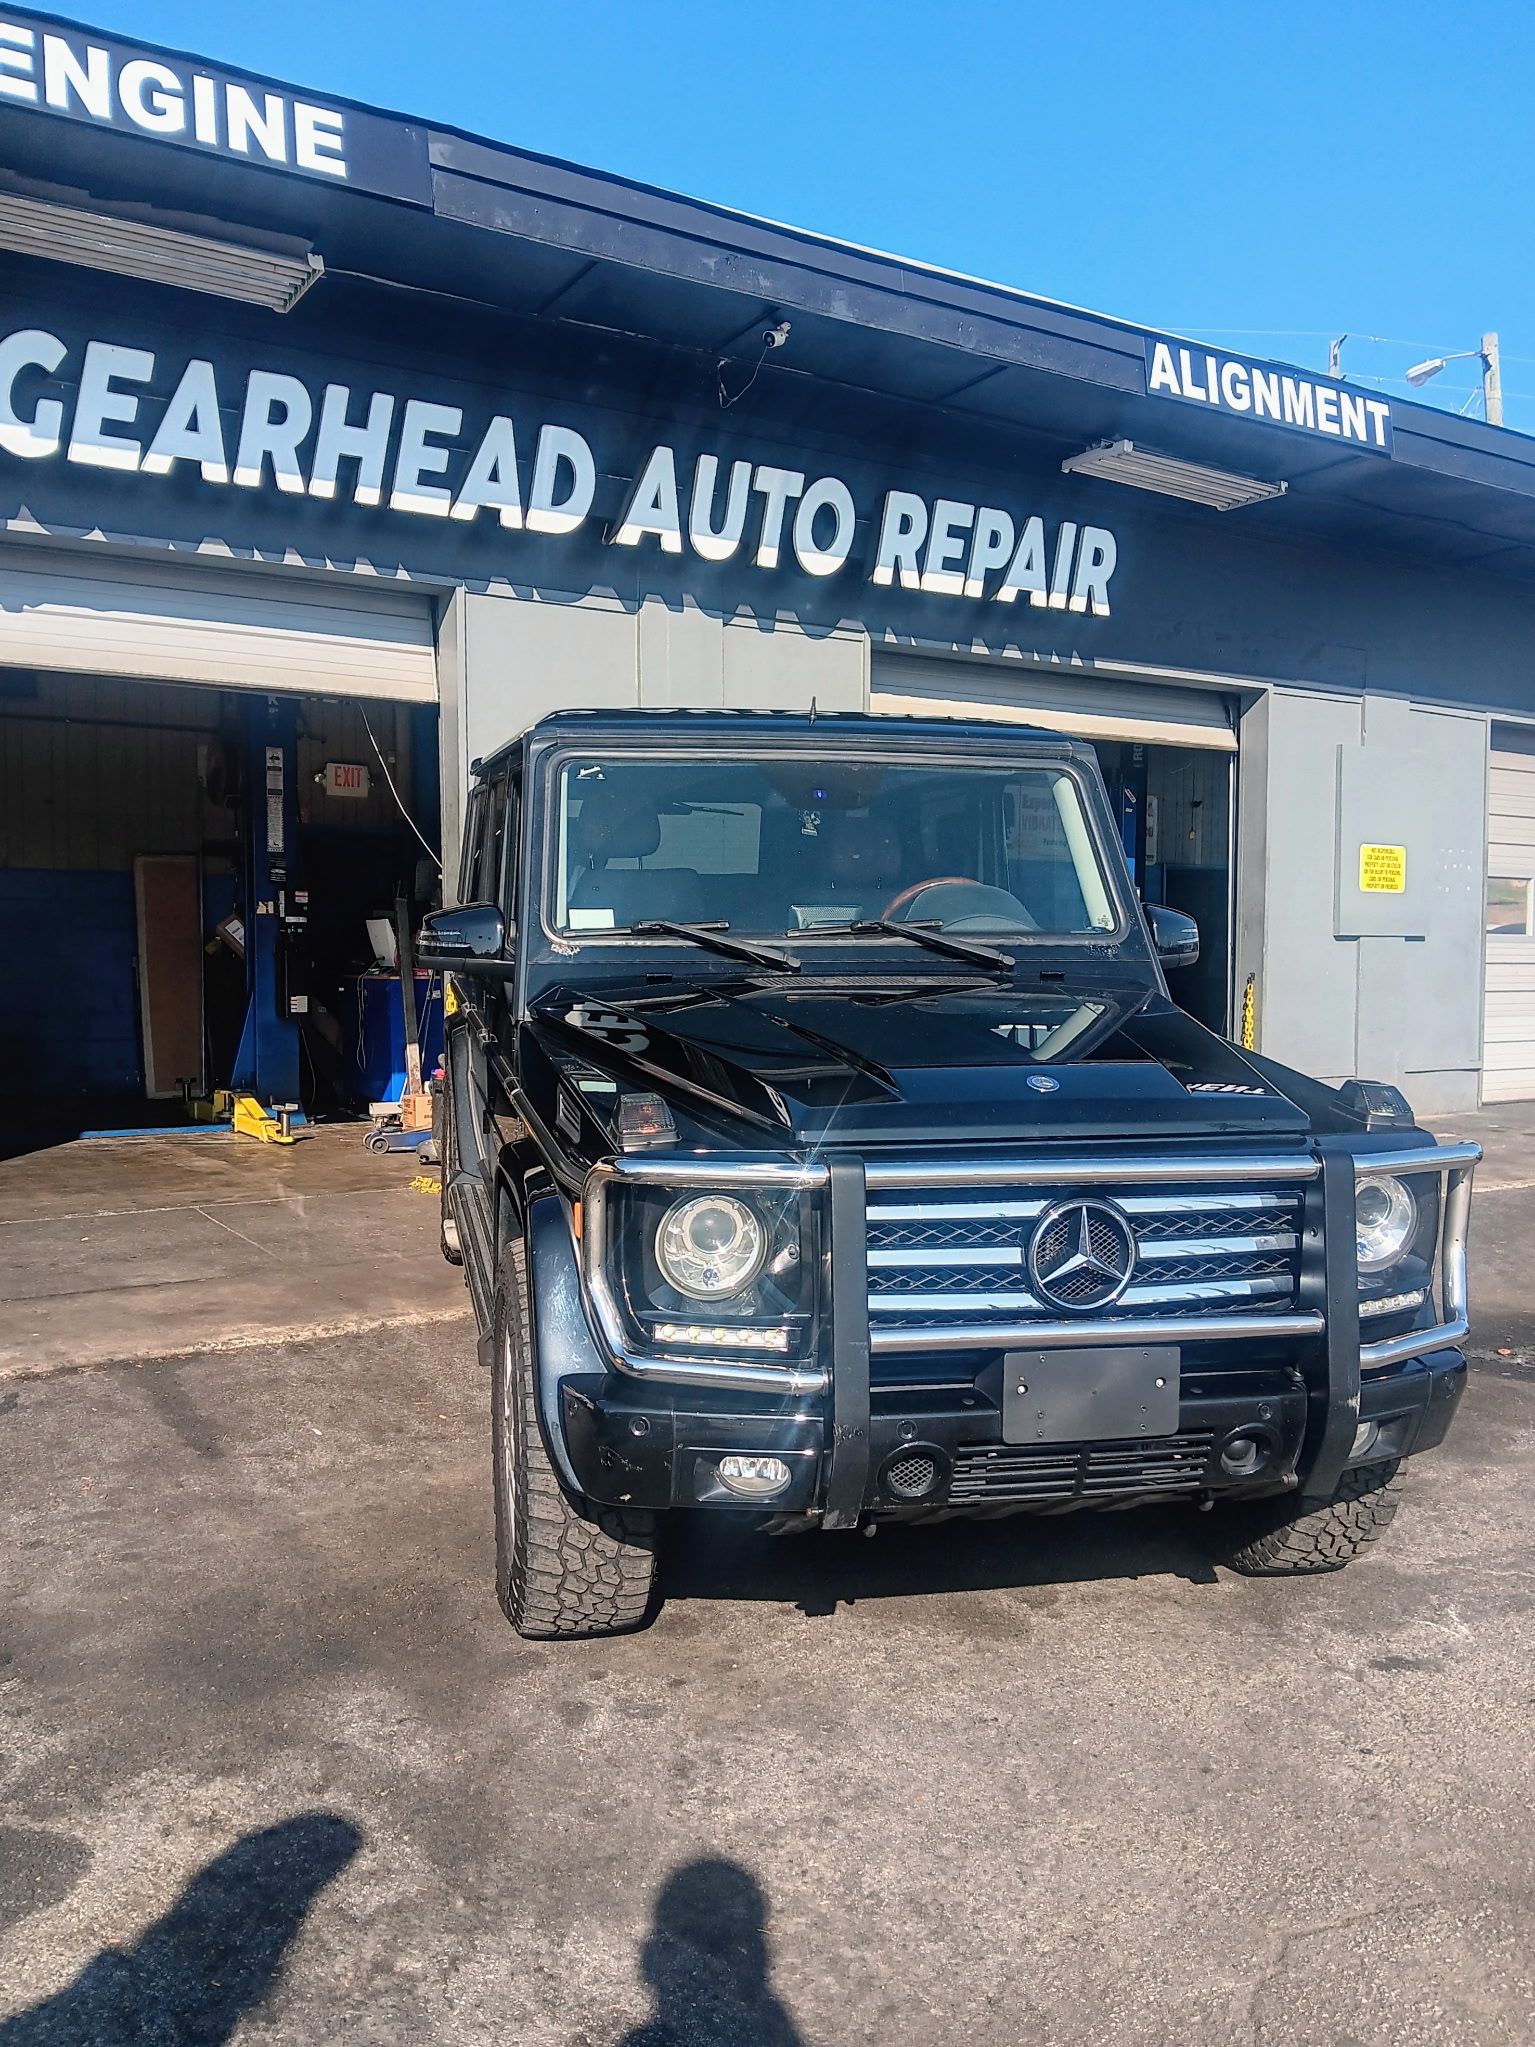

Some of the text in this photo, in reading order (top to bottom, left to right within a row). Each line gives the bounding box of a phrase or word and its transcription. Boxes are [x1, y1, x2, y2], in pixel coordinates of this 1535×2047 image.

[0, 22, 347, 178] ENGINE
[1149, 342, 1391, 447] ALIGNMENT
[0, 329, 1117, 617] GEARHEAD AUTO REPAIR
[334, 766, 363, 788] EXIT
